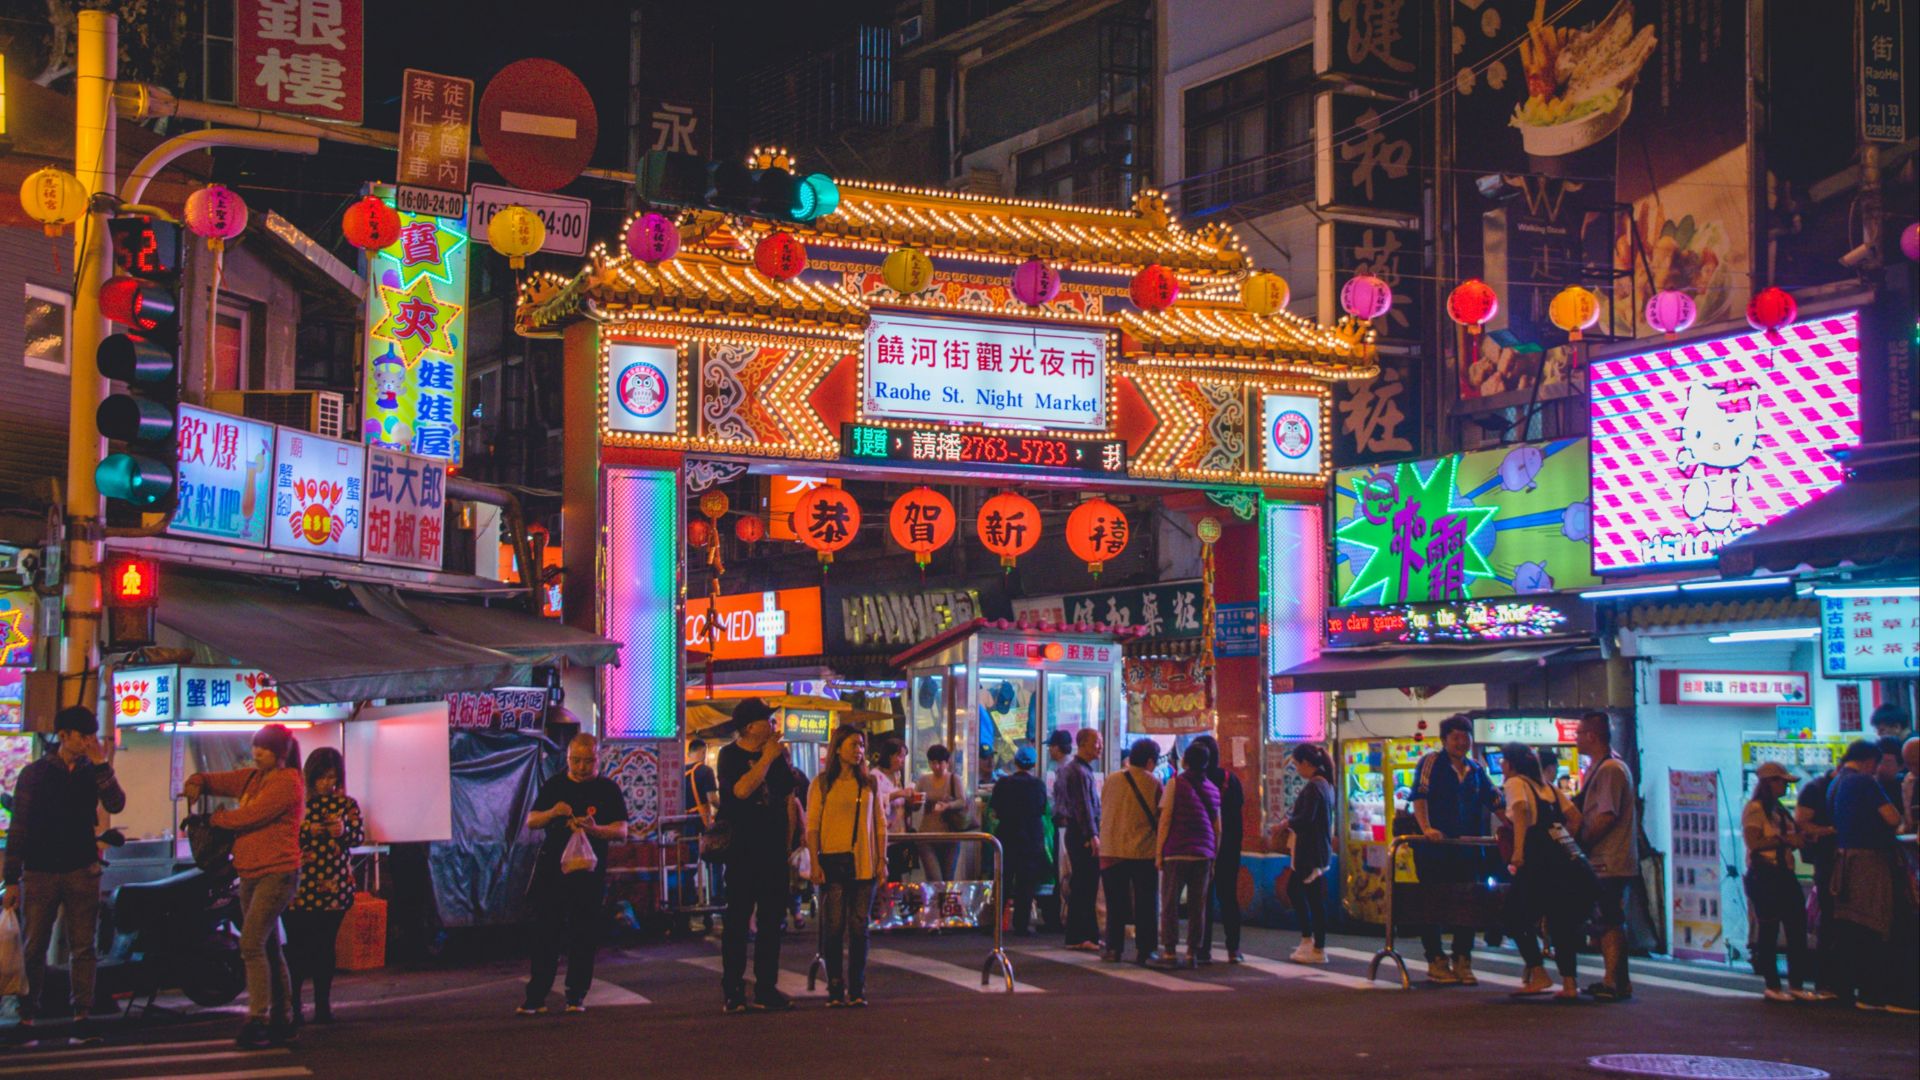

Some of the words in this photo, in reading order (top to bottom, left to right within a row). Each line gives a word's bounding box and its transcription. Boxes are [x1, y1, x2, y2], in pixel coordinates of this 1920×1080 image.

[407, 77, 435, 179] 禁止停車
[438, 82, 465, 184] 徒步區內
[400, 189, 461, 216] 16:00-24:00
[877, 334, 1096, 379] 饒河街觀光夜市
[416, 359, 455, 457] 娃娃屋
[875, 381, 931, 402] Raohe
[942, 386, 964, 404] St.
[976, 388, 1023, 411] Night
[1035, 392, 1097, 412] Market
[369, 456, 442, 510] 武大郎
[369, 506, 441, 562] 胡椒餅
[808, 500, 850, 543] 恭
[904, 501, 941, 545] 賀
[986, 510, 1027, 548] 新
[1090, 517, 1126, 554] 禧
[685, 610, 754, 646] COMED
[1346, 613, 1370, 632] claw
[1373, 615, 1405, 633] games
[1067, 644, 1110, 662] 服務台
